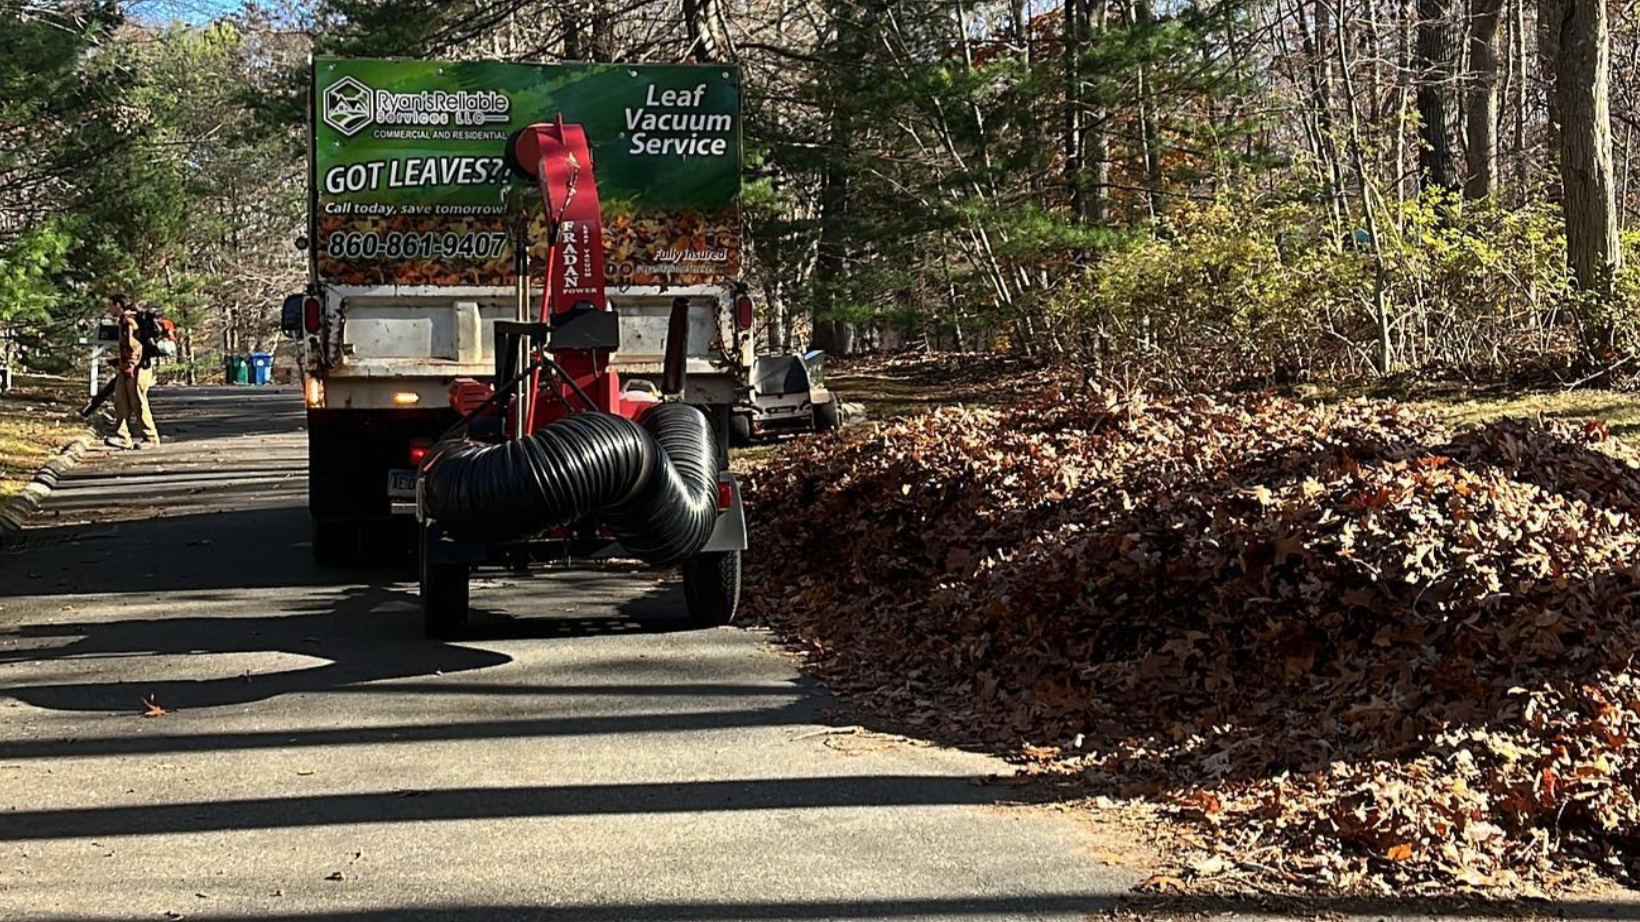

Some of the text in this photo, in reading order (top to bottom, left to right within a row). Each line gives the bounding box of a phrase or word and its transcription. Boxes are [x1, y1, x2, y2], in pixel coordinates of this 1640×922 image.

[646, 84, 706, 106] Leaf
[376, 111, 485, 125] Services LLC
[625, 108, 732, 131] Vacuum
[373, 130, 507, 140] COMMERCIAL AND RESIDENTIAL
[629, 132, 726, 155] Service
[326, 162, 384, 194] GOT
[325, 202, 351, 214] Call
[354, 203, 397, 216] today,
[400, 204, 431, 214] save
[328, 231, 507, 259] 860-861-9407
[562, 221, 579, 288] FRADAN
[653, 248, 728, 263] Fully Insured
